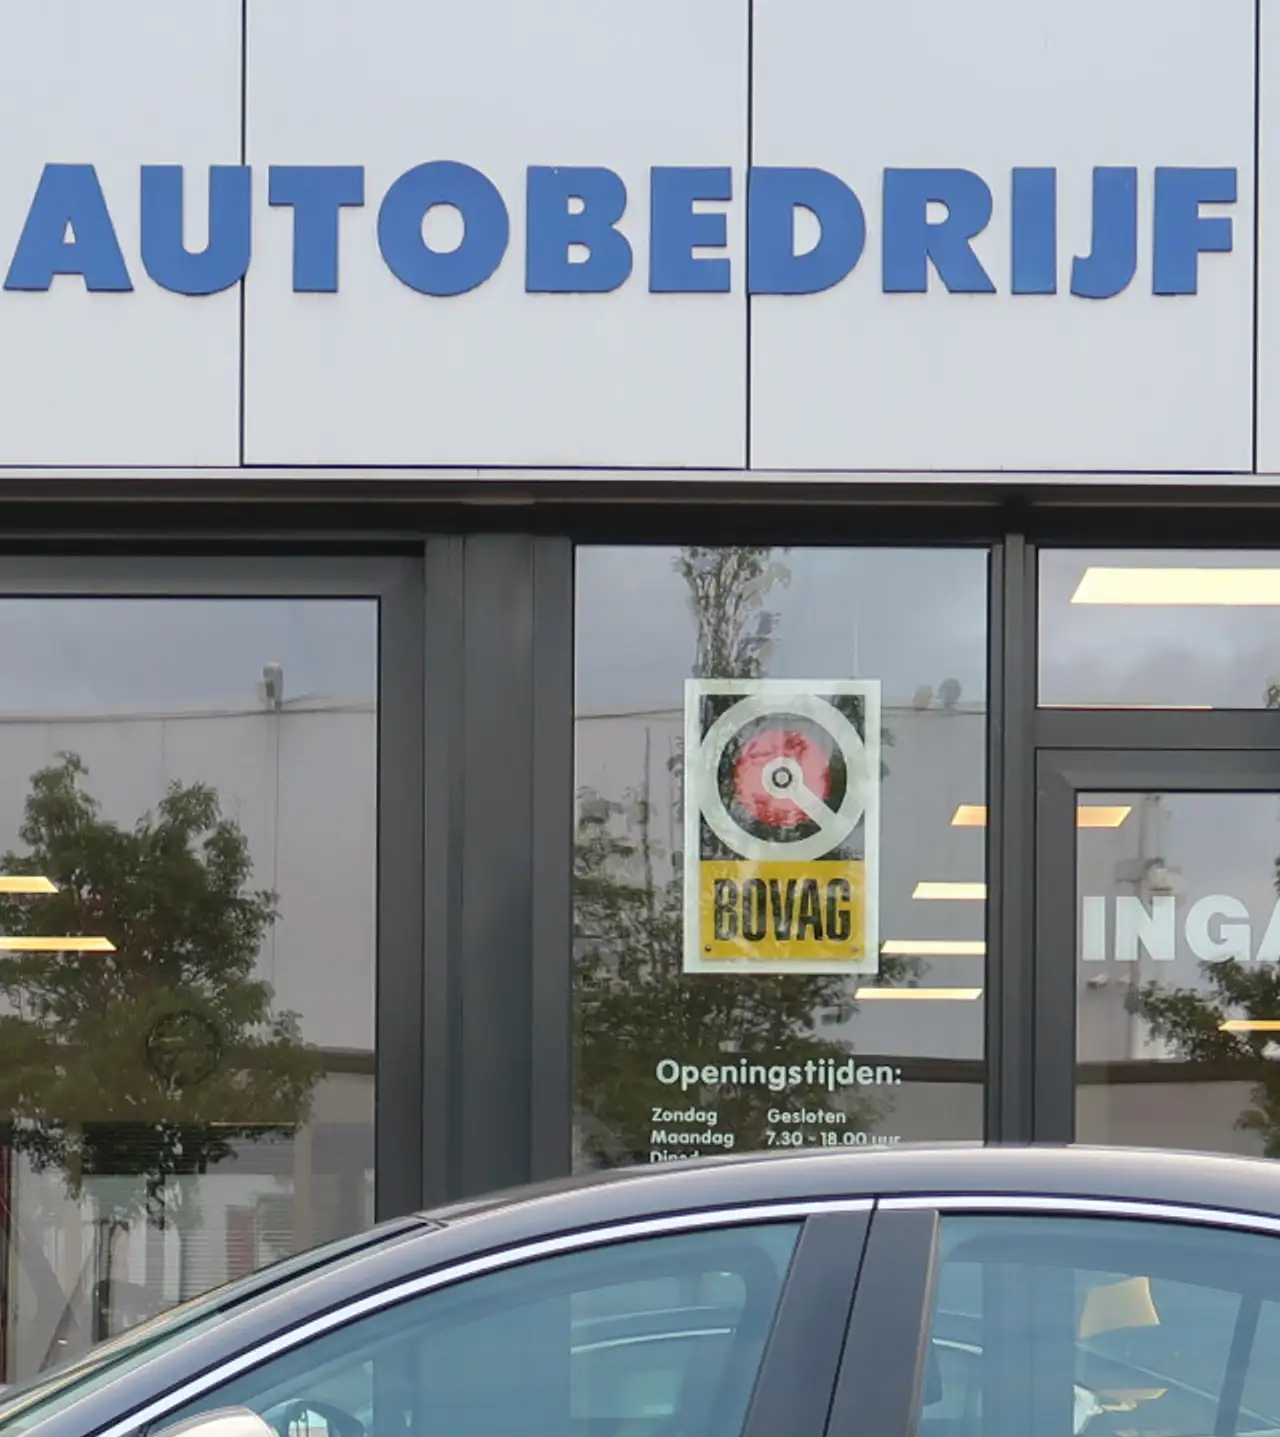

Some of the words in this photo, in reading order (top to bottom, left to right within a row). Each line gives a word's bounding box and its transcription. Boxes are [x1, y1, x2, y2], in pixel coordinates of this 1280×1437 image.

[4, 160, 1238, 298] AUTOBEDRIJF
[713, 877, 852, 942] BOVAG
[656, 1058, 903, 1091] Openingstijden:
[651, 1107, 718, 1126] Zondag
[767, 1107, 847, 1124] Gesloten
[650, 1130, 735, 1148] Maandag
[766, 1131, 803, 1146] 7.30
[821, 1131, 867, 1146] 18.00
